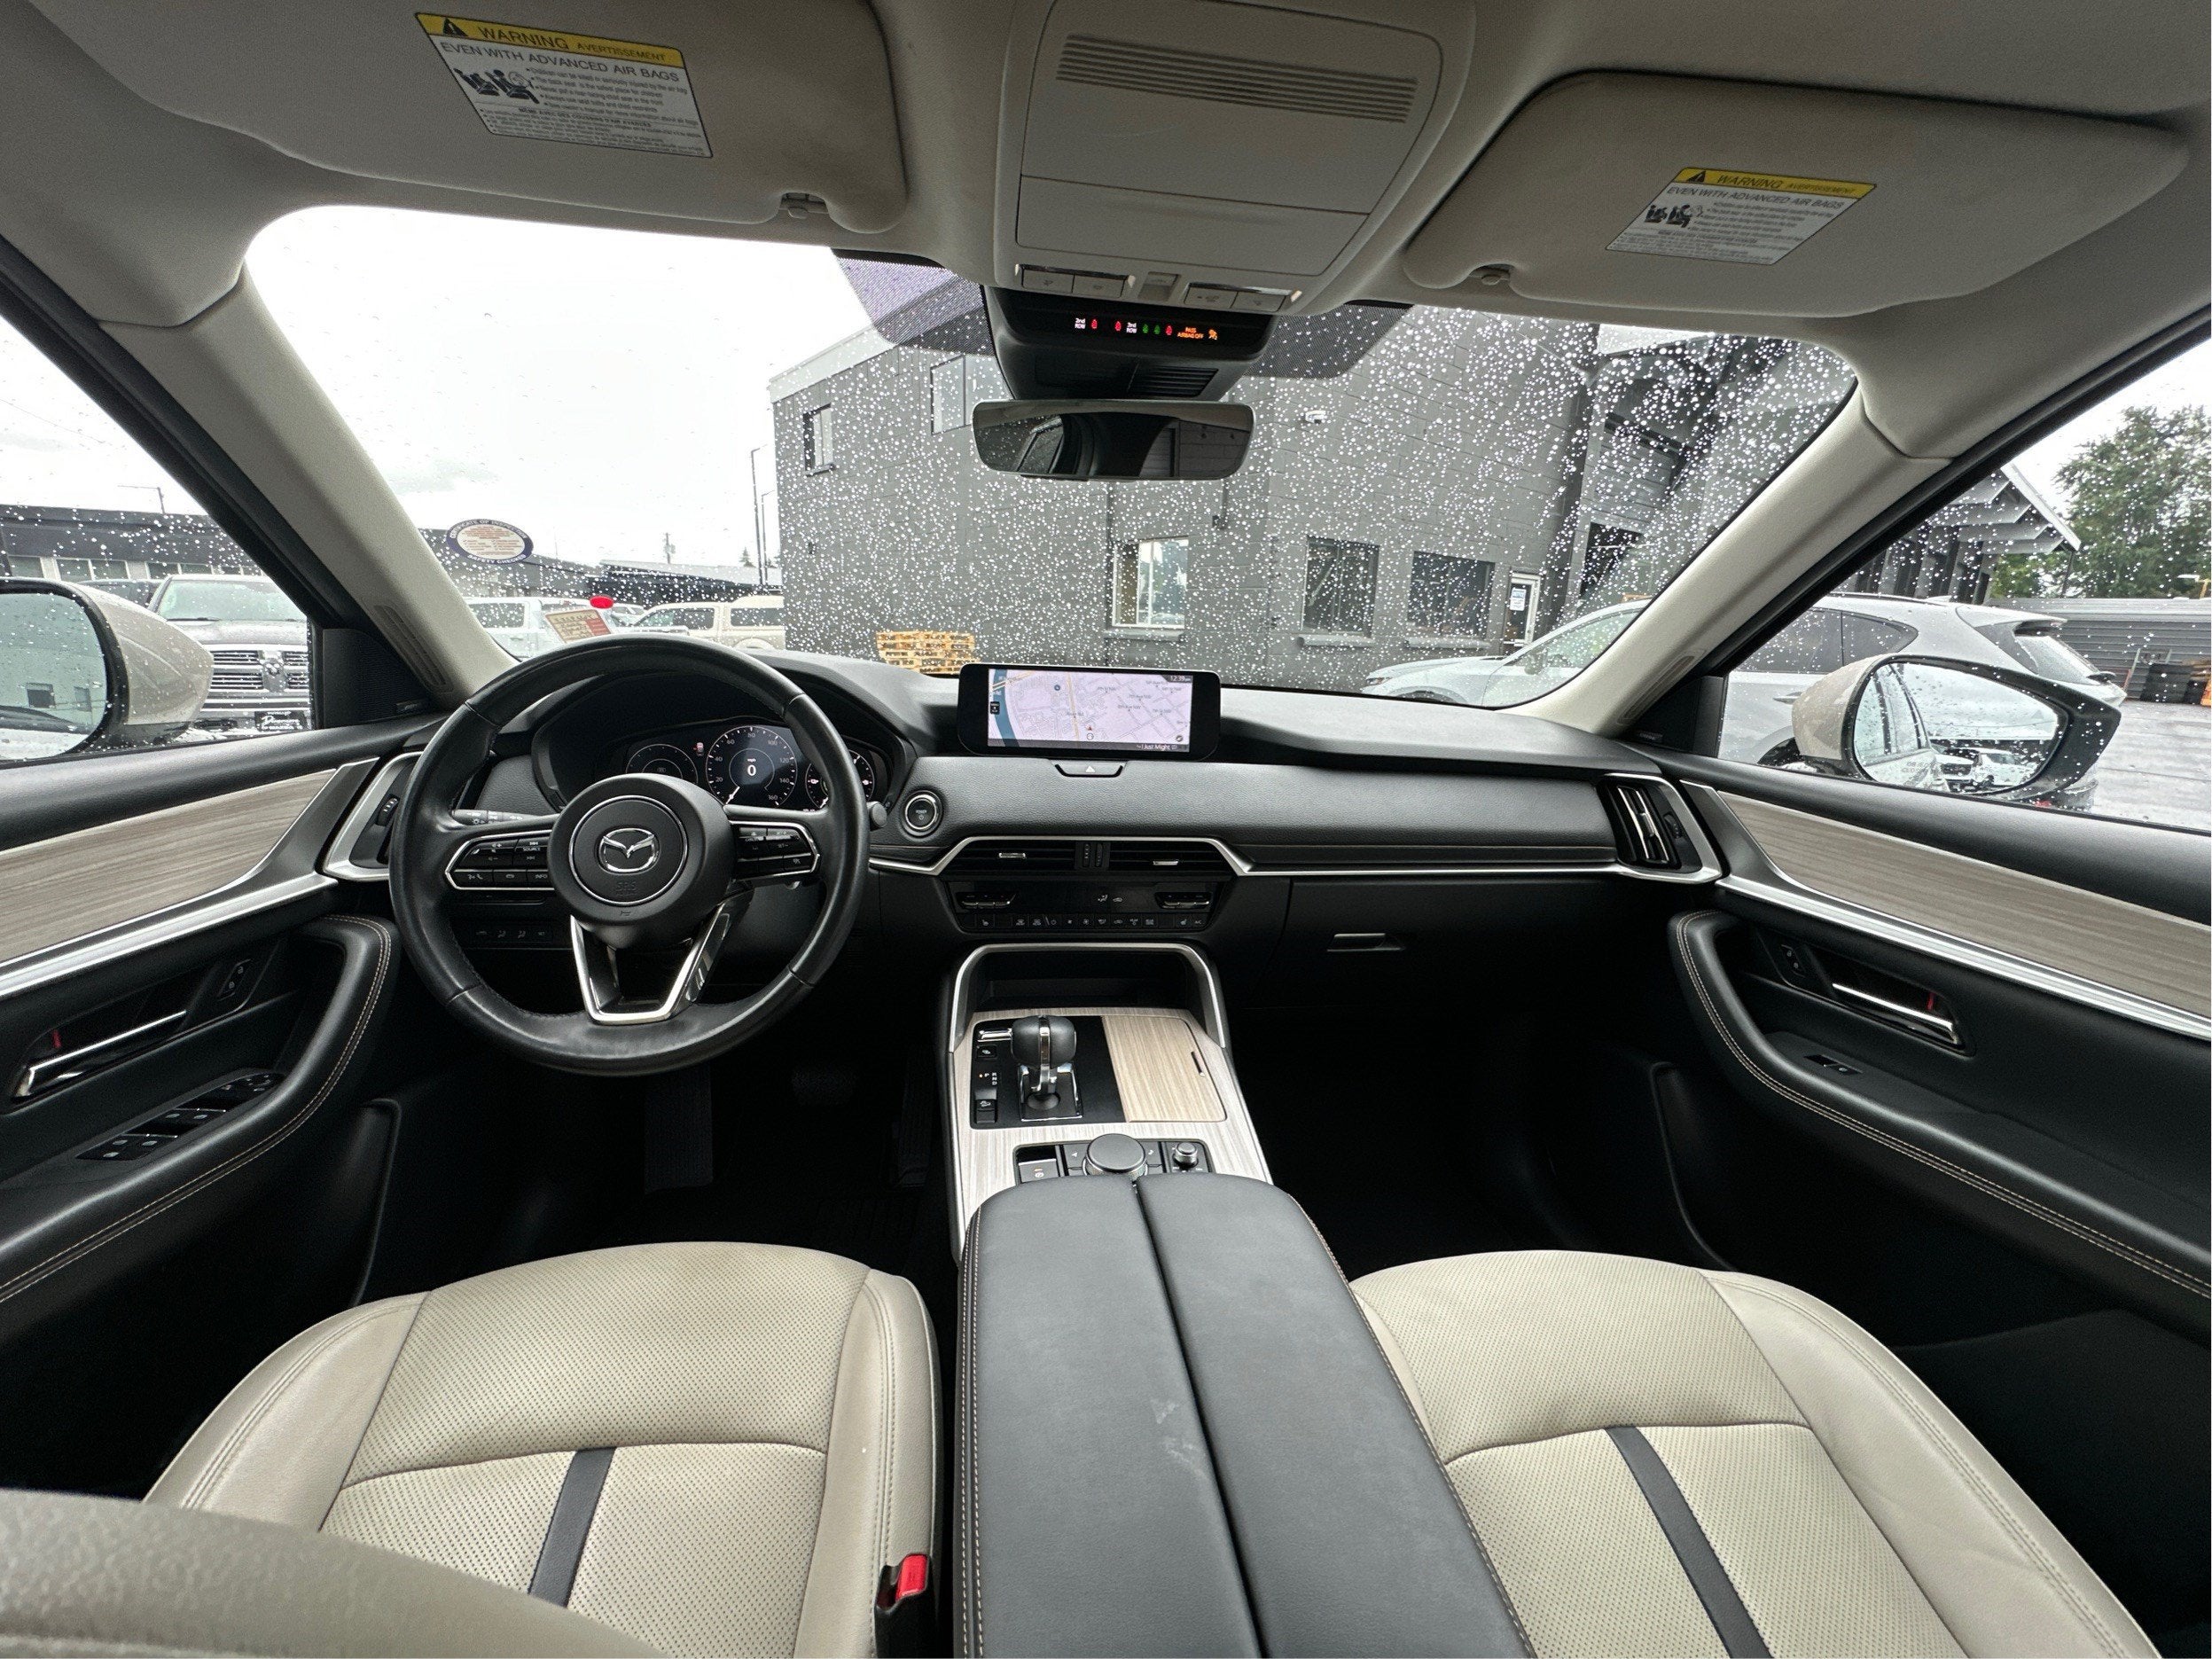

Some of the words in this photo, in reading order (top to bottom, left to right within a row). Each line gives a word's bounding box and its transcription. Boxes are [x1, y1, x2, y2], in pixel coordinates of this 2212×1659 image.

[479, 26, 569, 50] WARNING
[576, 42, 667, 61] AVERTISSEMENT
[440, 40, 484, 56] EVEN
[482, 46, 525, 61] WITH
[526, 52, 609, 73] ADVANCED
[610, 64, 638, 76] AIR
[639, 67, 680, 82] BAGS
[1717, 175, 1783, 189] WARNING
[1786, 183, 1856, 194] AVERTISSEMENT
[1667, 186, 1697, 195] EVEN
[1698, 188, 1726, 198] WITH
[1729, 192, 1791, 204] ADVANCED
[1792, 197, 1813, 206] AIR
[1811, 199, 1845, 209] BAGS
[467, 554, 495, 564] SAFETY
[746, 765, 756, 776] 0
